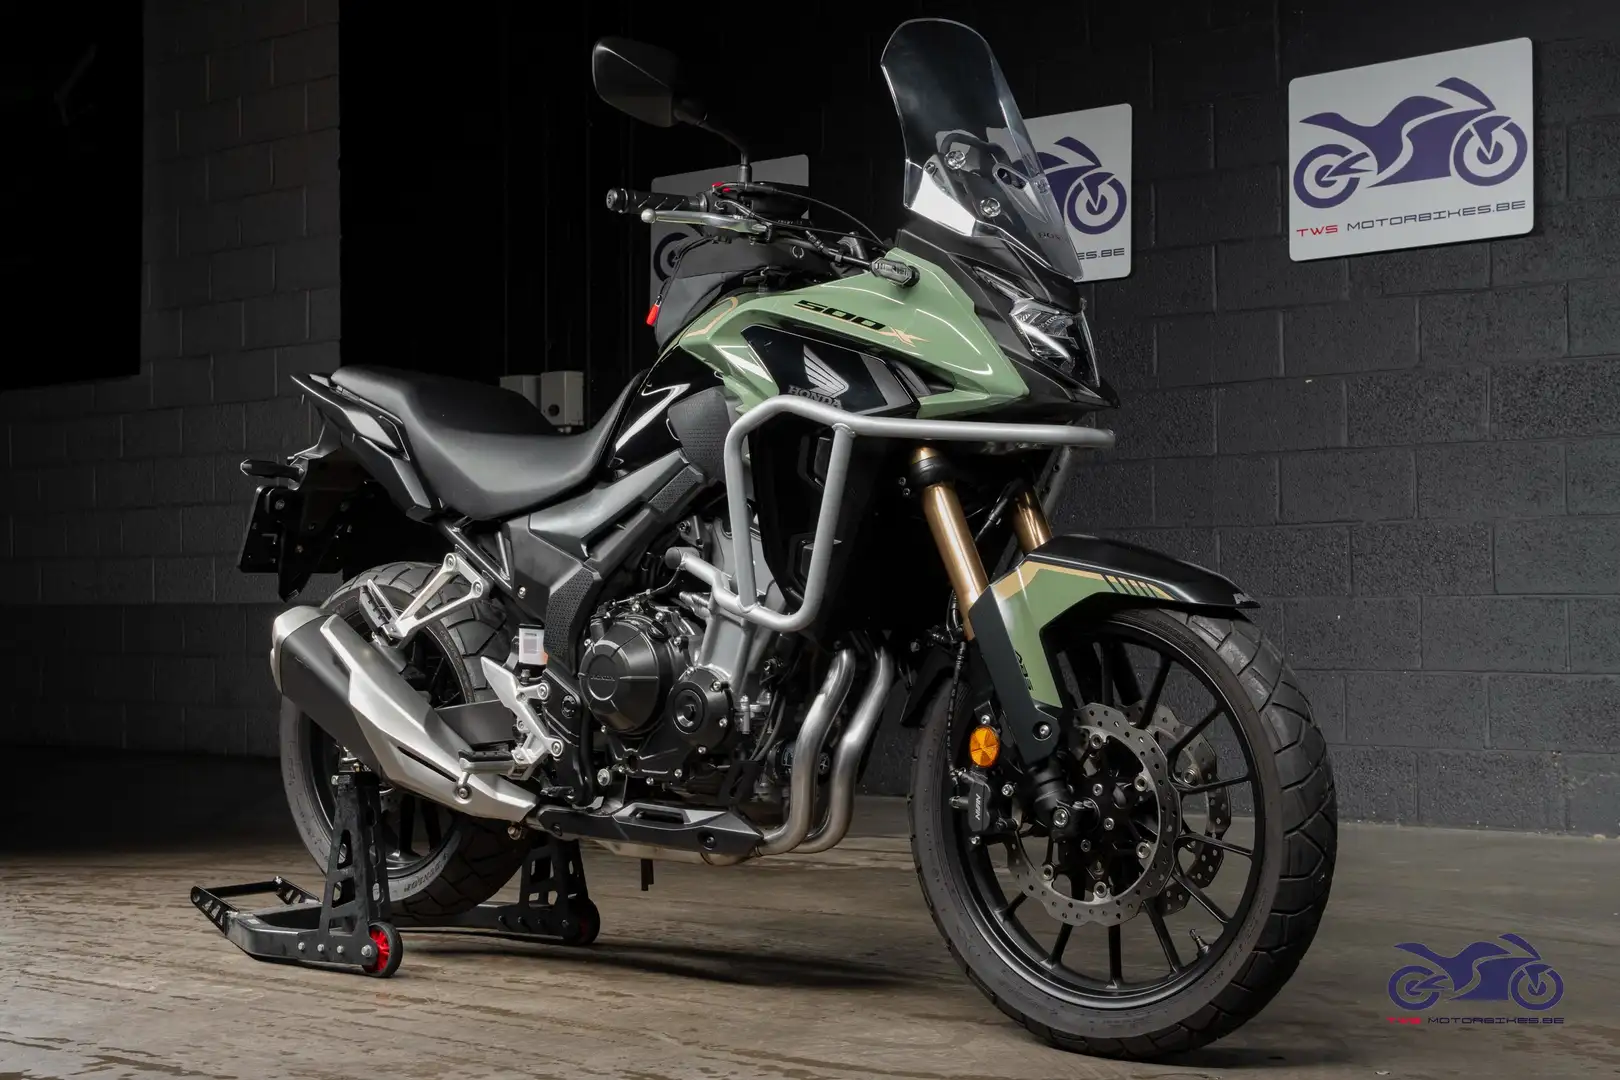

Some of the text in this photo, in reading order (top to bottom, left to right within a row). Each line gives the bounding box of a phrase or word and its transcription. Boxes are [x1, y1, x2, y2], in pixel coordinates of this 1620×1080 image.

[1296, 200, 1526, 237] TWS MOTORBIKES.BE
[1077, 247, 1125, 260] ES.BE
[787, 384, 843, 410] HONDA
